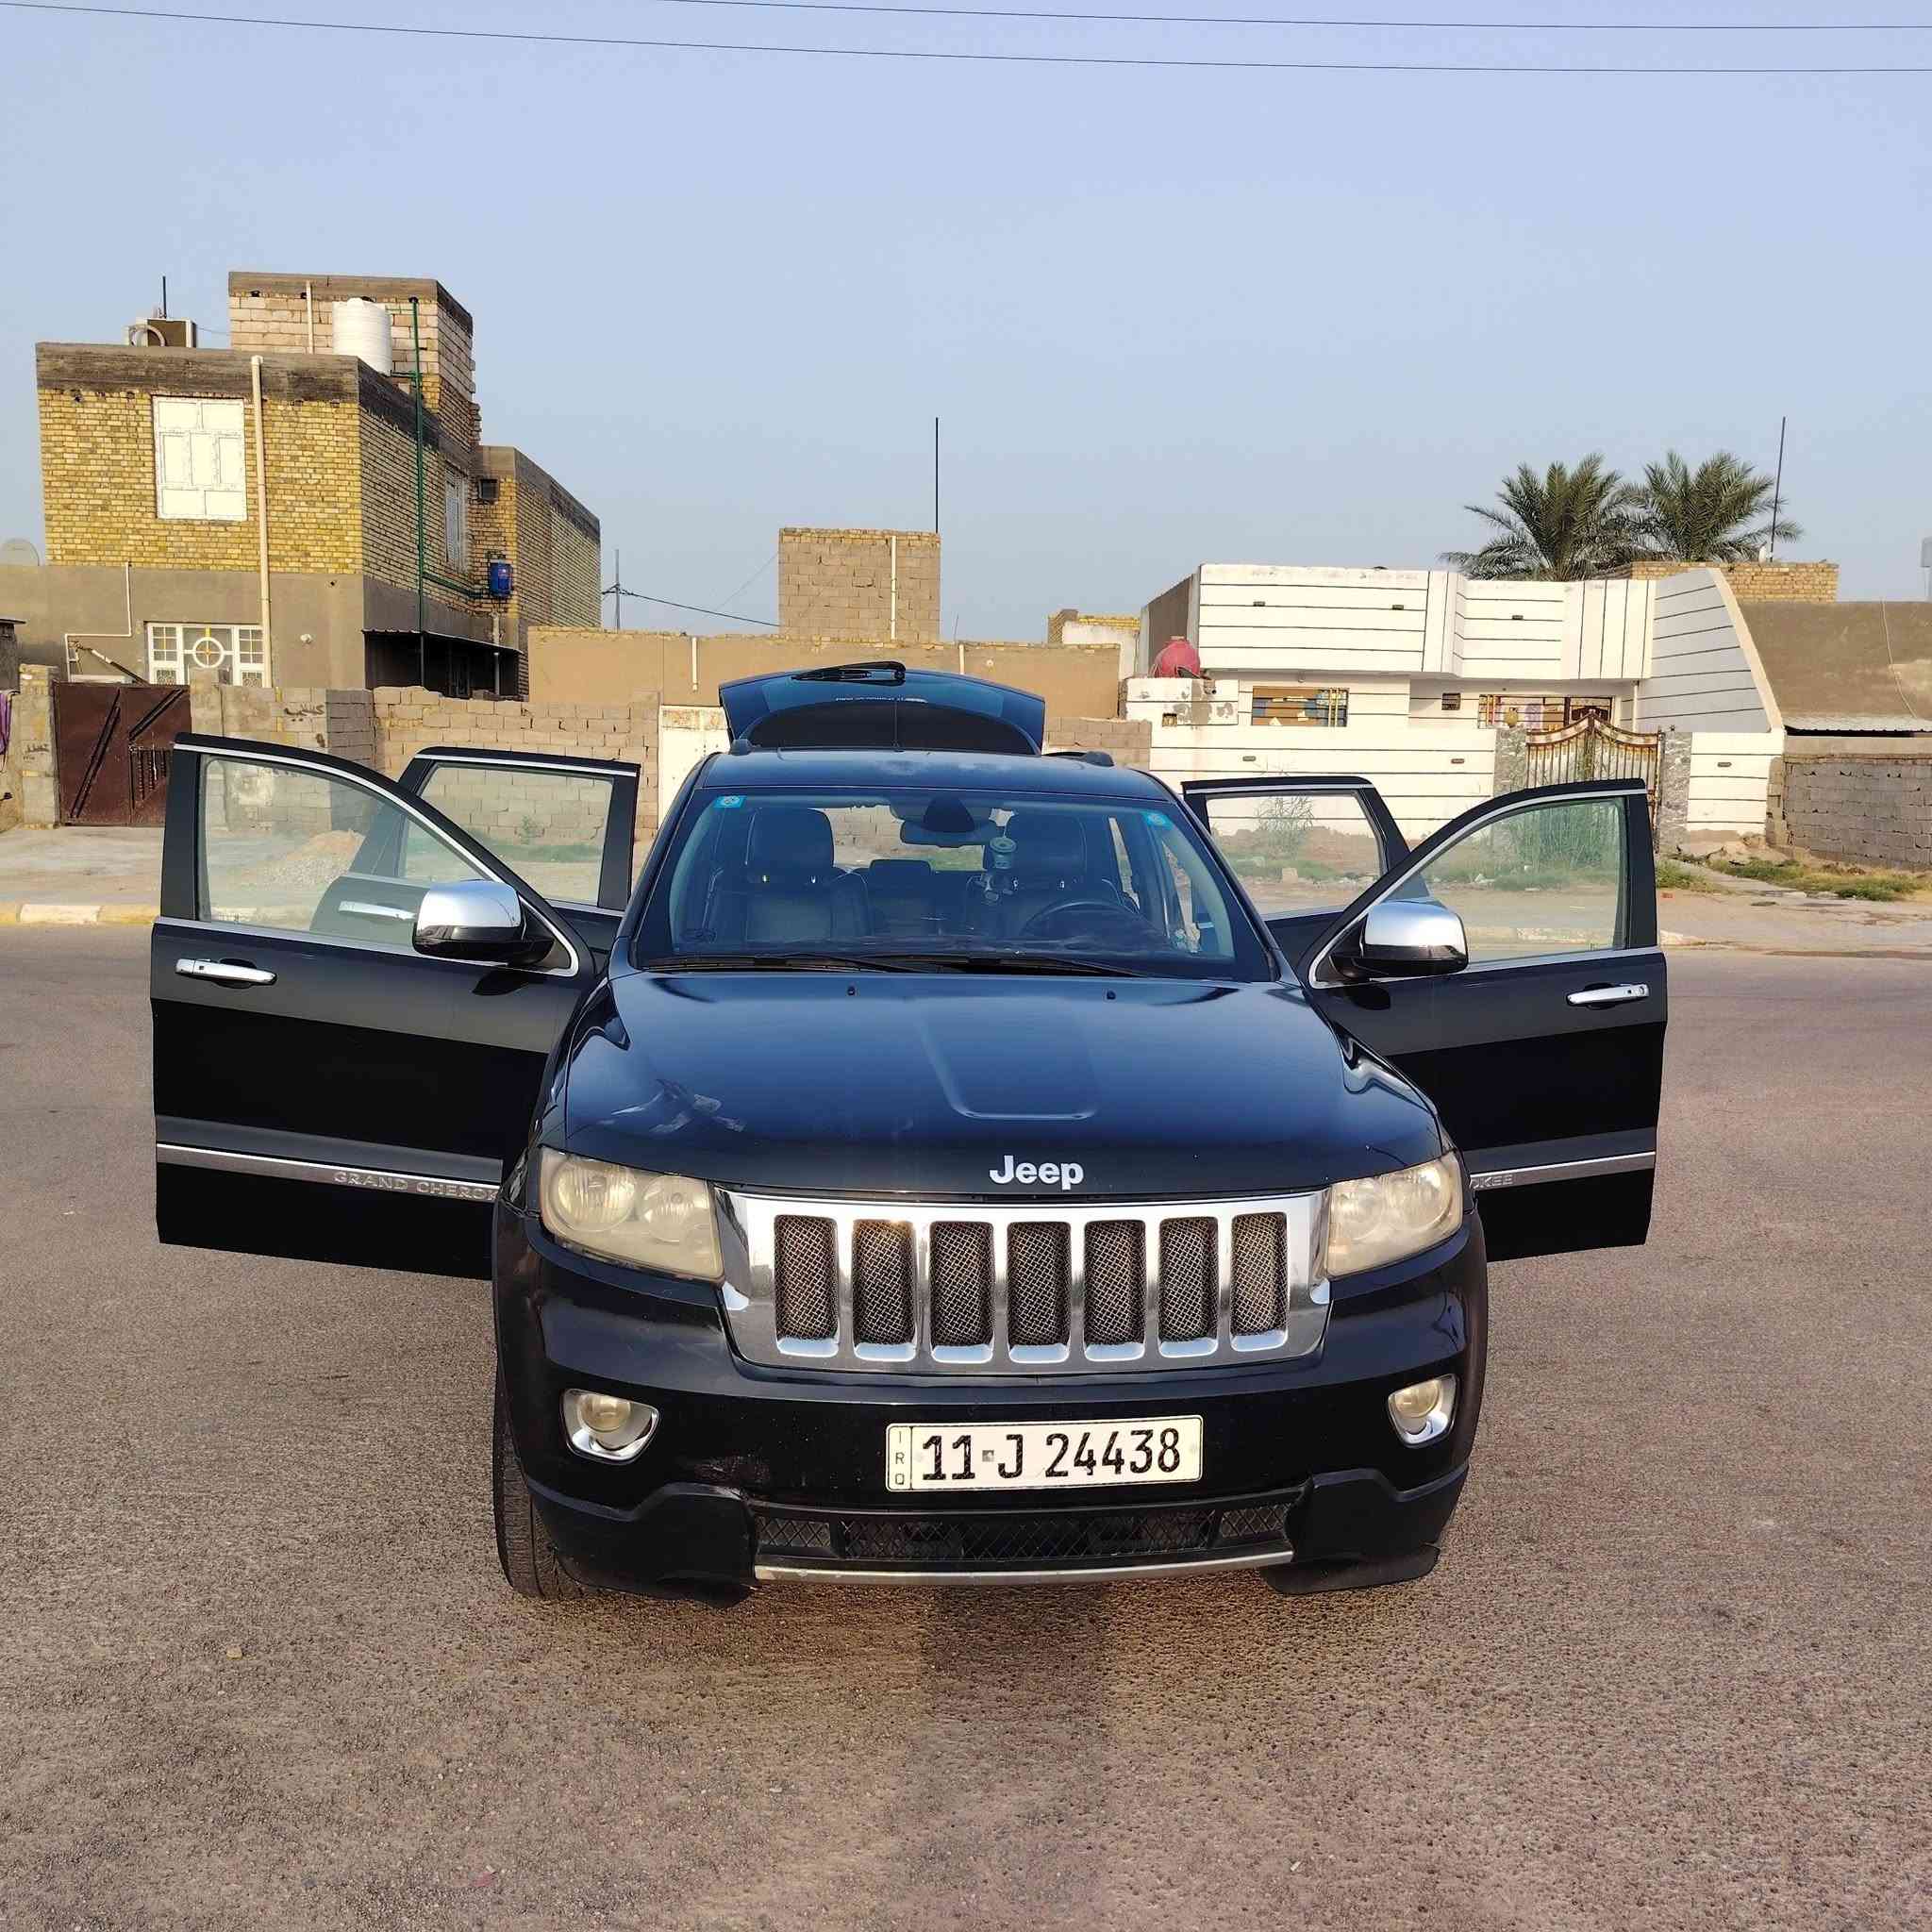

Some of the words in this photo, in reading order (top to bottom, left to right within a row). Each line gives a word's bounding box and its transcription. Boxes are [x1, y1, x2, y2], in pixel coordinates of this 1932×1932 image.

[333, 1171, 408, 1191] GRAND
[989, 1155, 1084, 1190] Jeep
[922, 1434, 975, 1481] 11
[997, 1433, 1024, 1479] J
[1045, 1427, 1181, 1478] 24438
